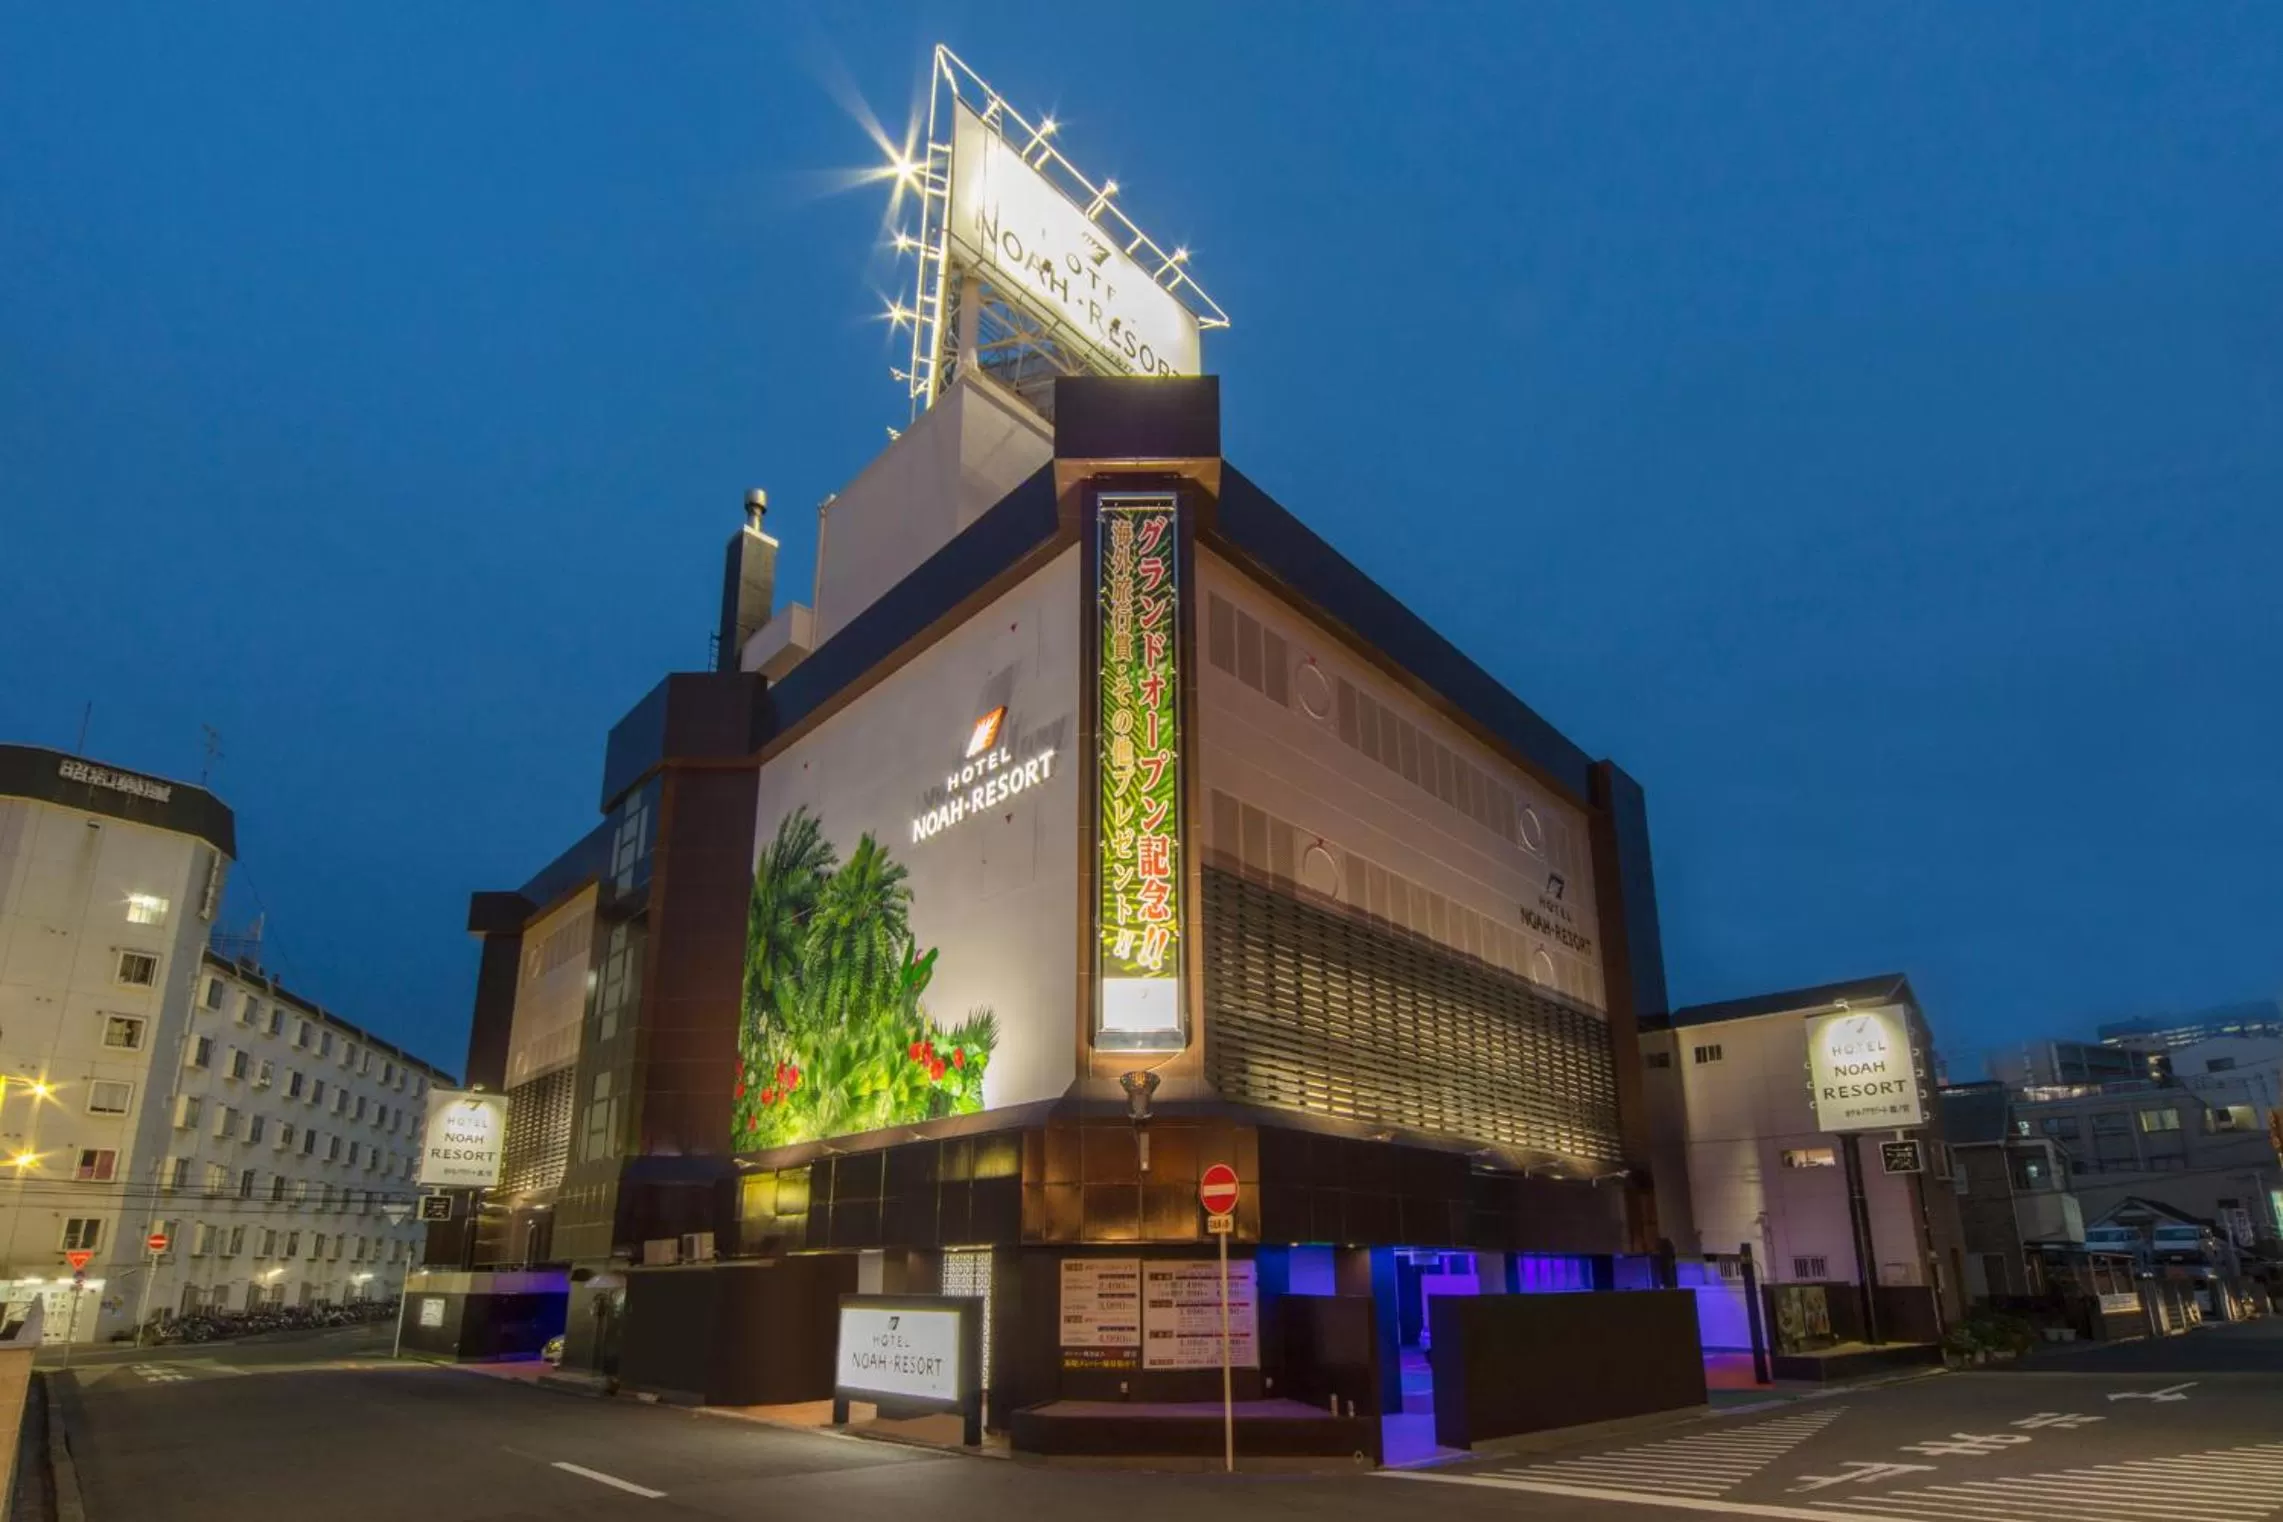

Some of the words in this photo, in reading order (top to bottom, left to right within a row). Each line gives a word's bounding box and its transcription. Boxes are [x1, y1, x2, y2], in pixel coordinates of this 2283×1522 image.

[947, 746, 1011, 792] HOTEL
[1832, 1040, 1887, 1057] HOTEL
[1834, 1061, 1886, 1077] NOAH
[1823, 1079, 1907, 1100] RESORT
[447, 1117, 488, 1128] HOTEL
[444, 1133, 485, 1145] NOAH
[430, 1149, 496, 1163] RESORT
[872, 1334, 910, 1348] HOTEL
